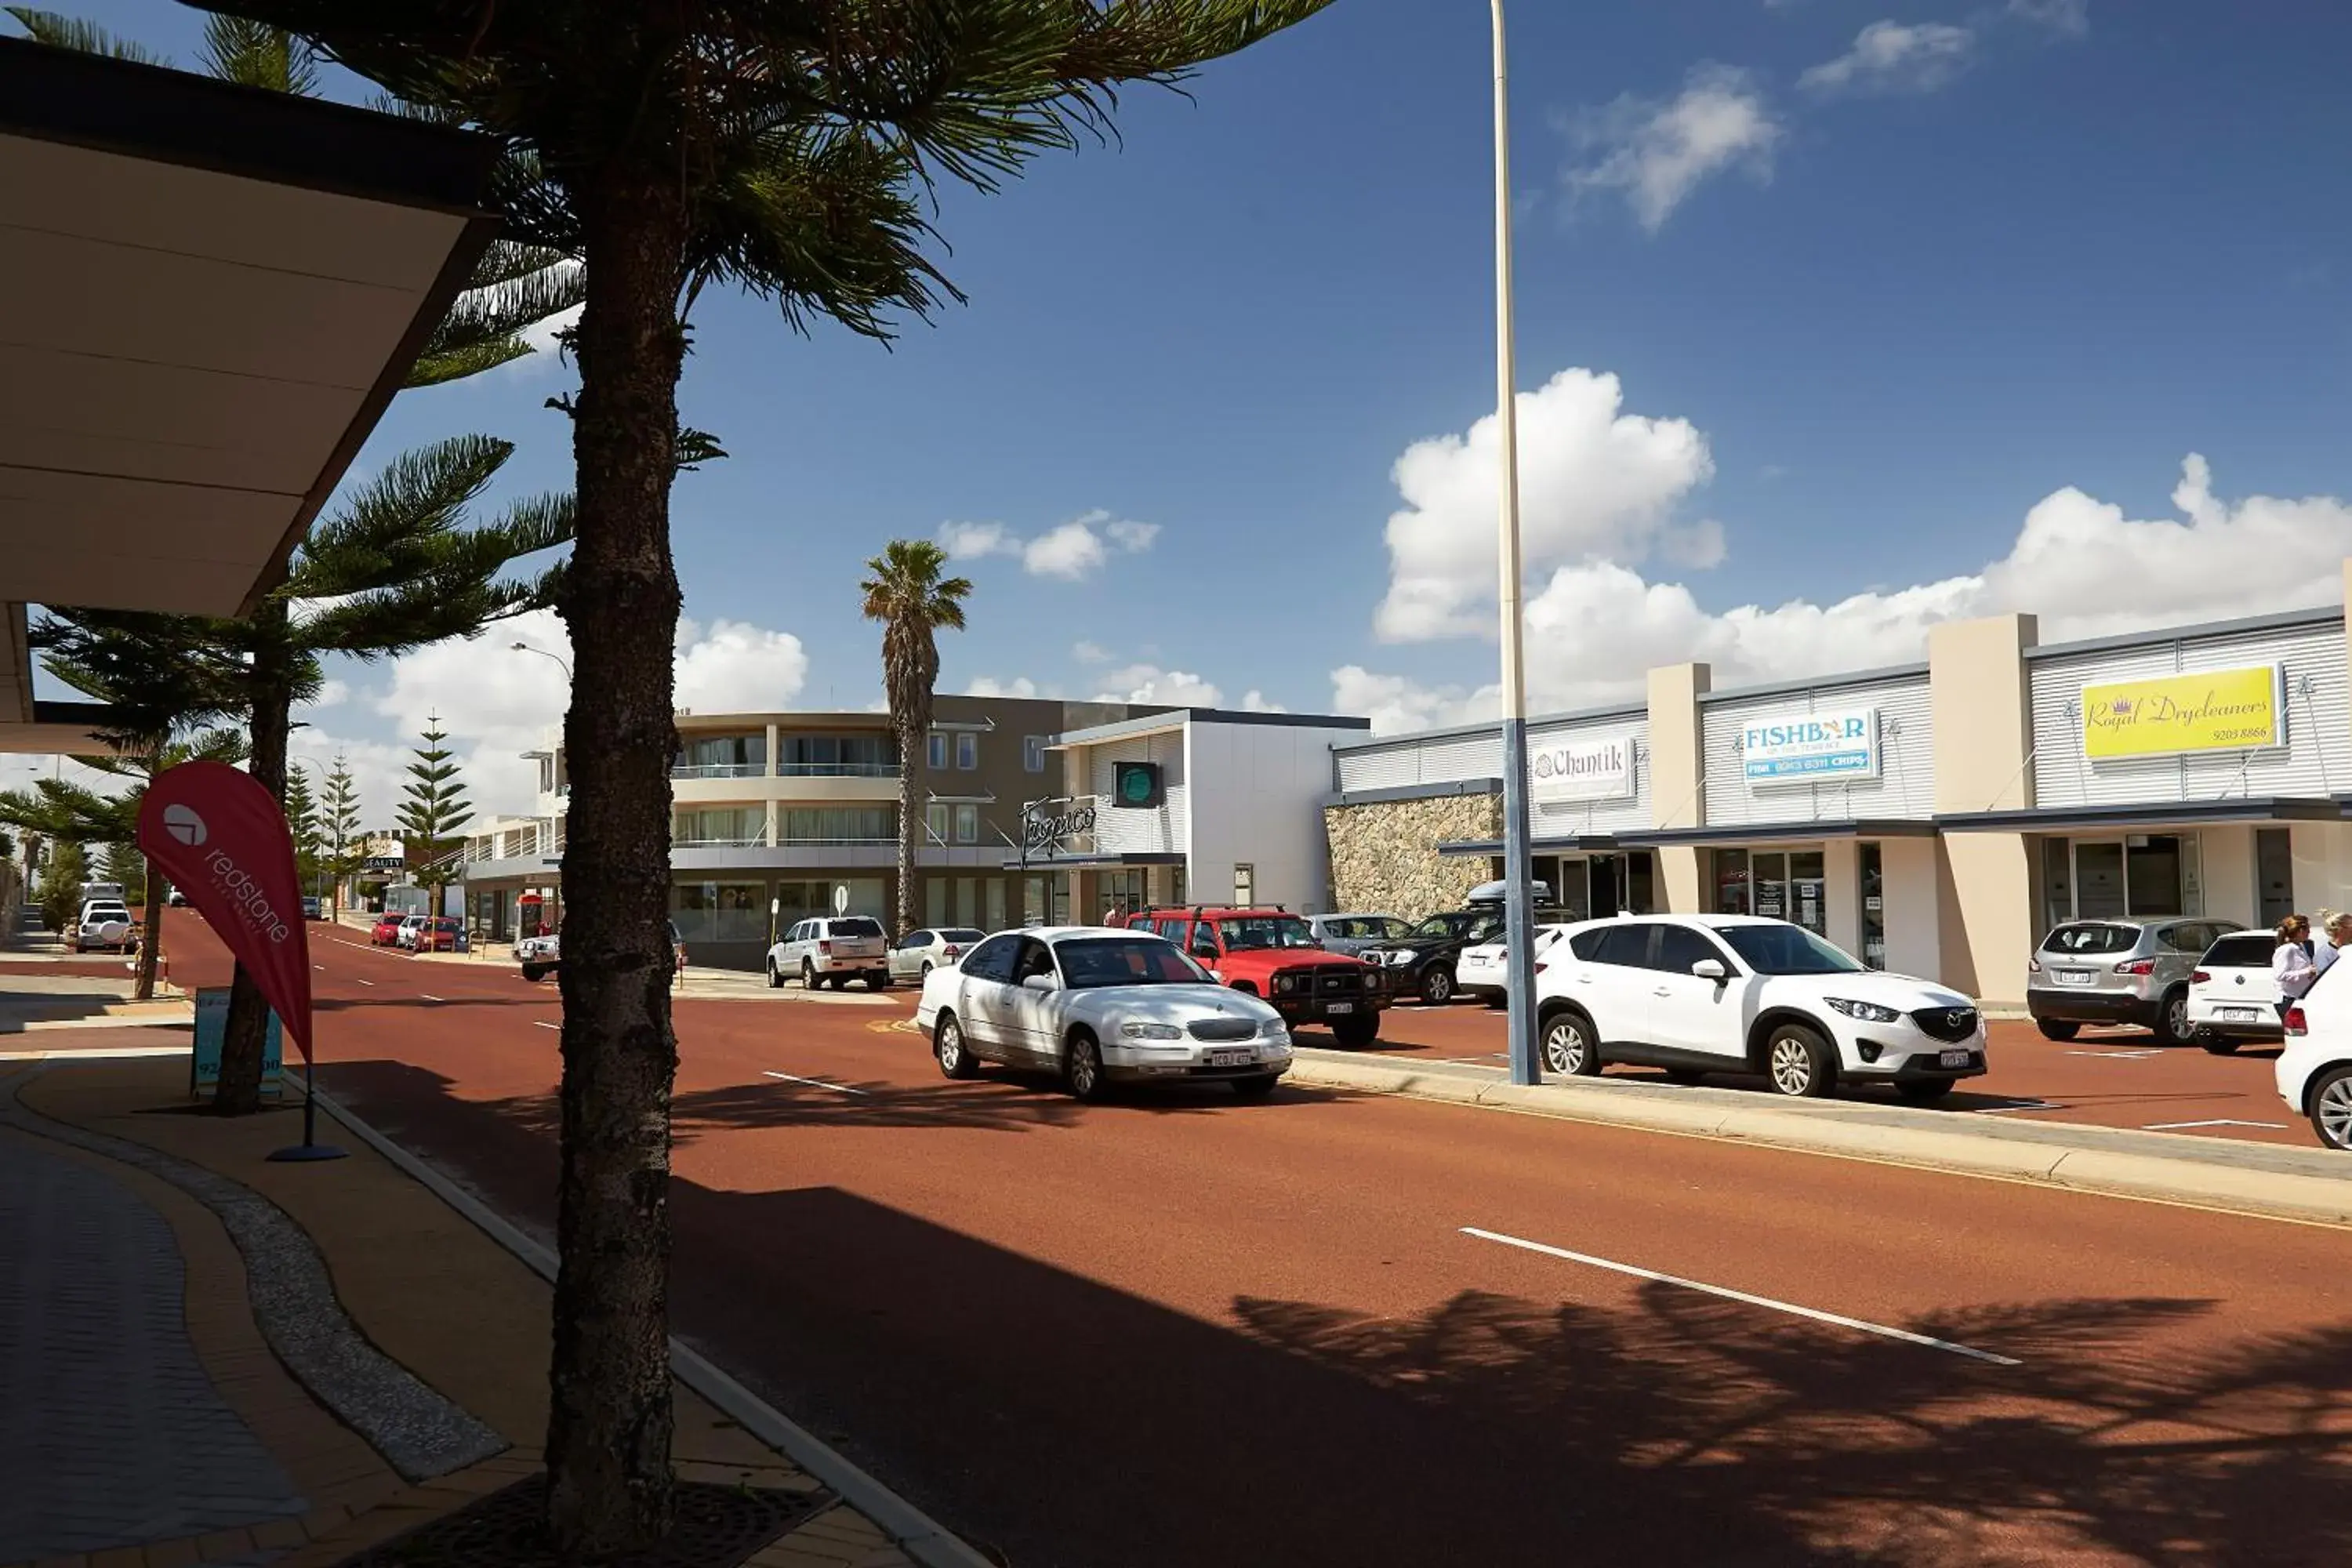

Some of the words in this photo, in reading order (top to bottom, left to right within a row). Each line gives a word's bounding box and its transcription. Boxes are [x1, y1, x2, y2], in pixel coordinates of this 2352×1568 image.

[2086, 696, 2144, 732] Royal
[2147, 689, 2267, 725] Drycleaners
[1553, 745, 1622, 776] Chantik
[204, 848, 289, 943] redstone
